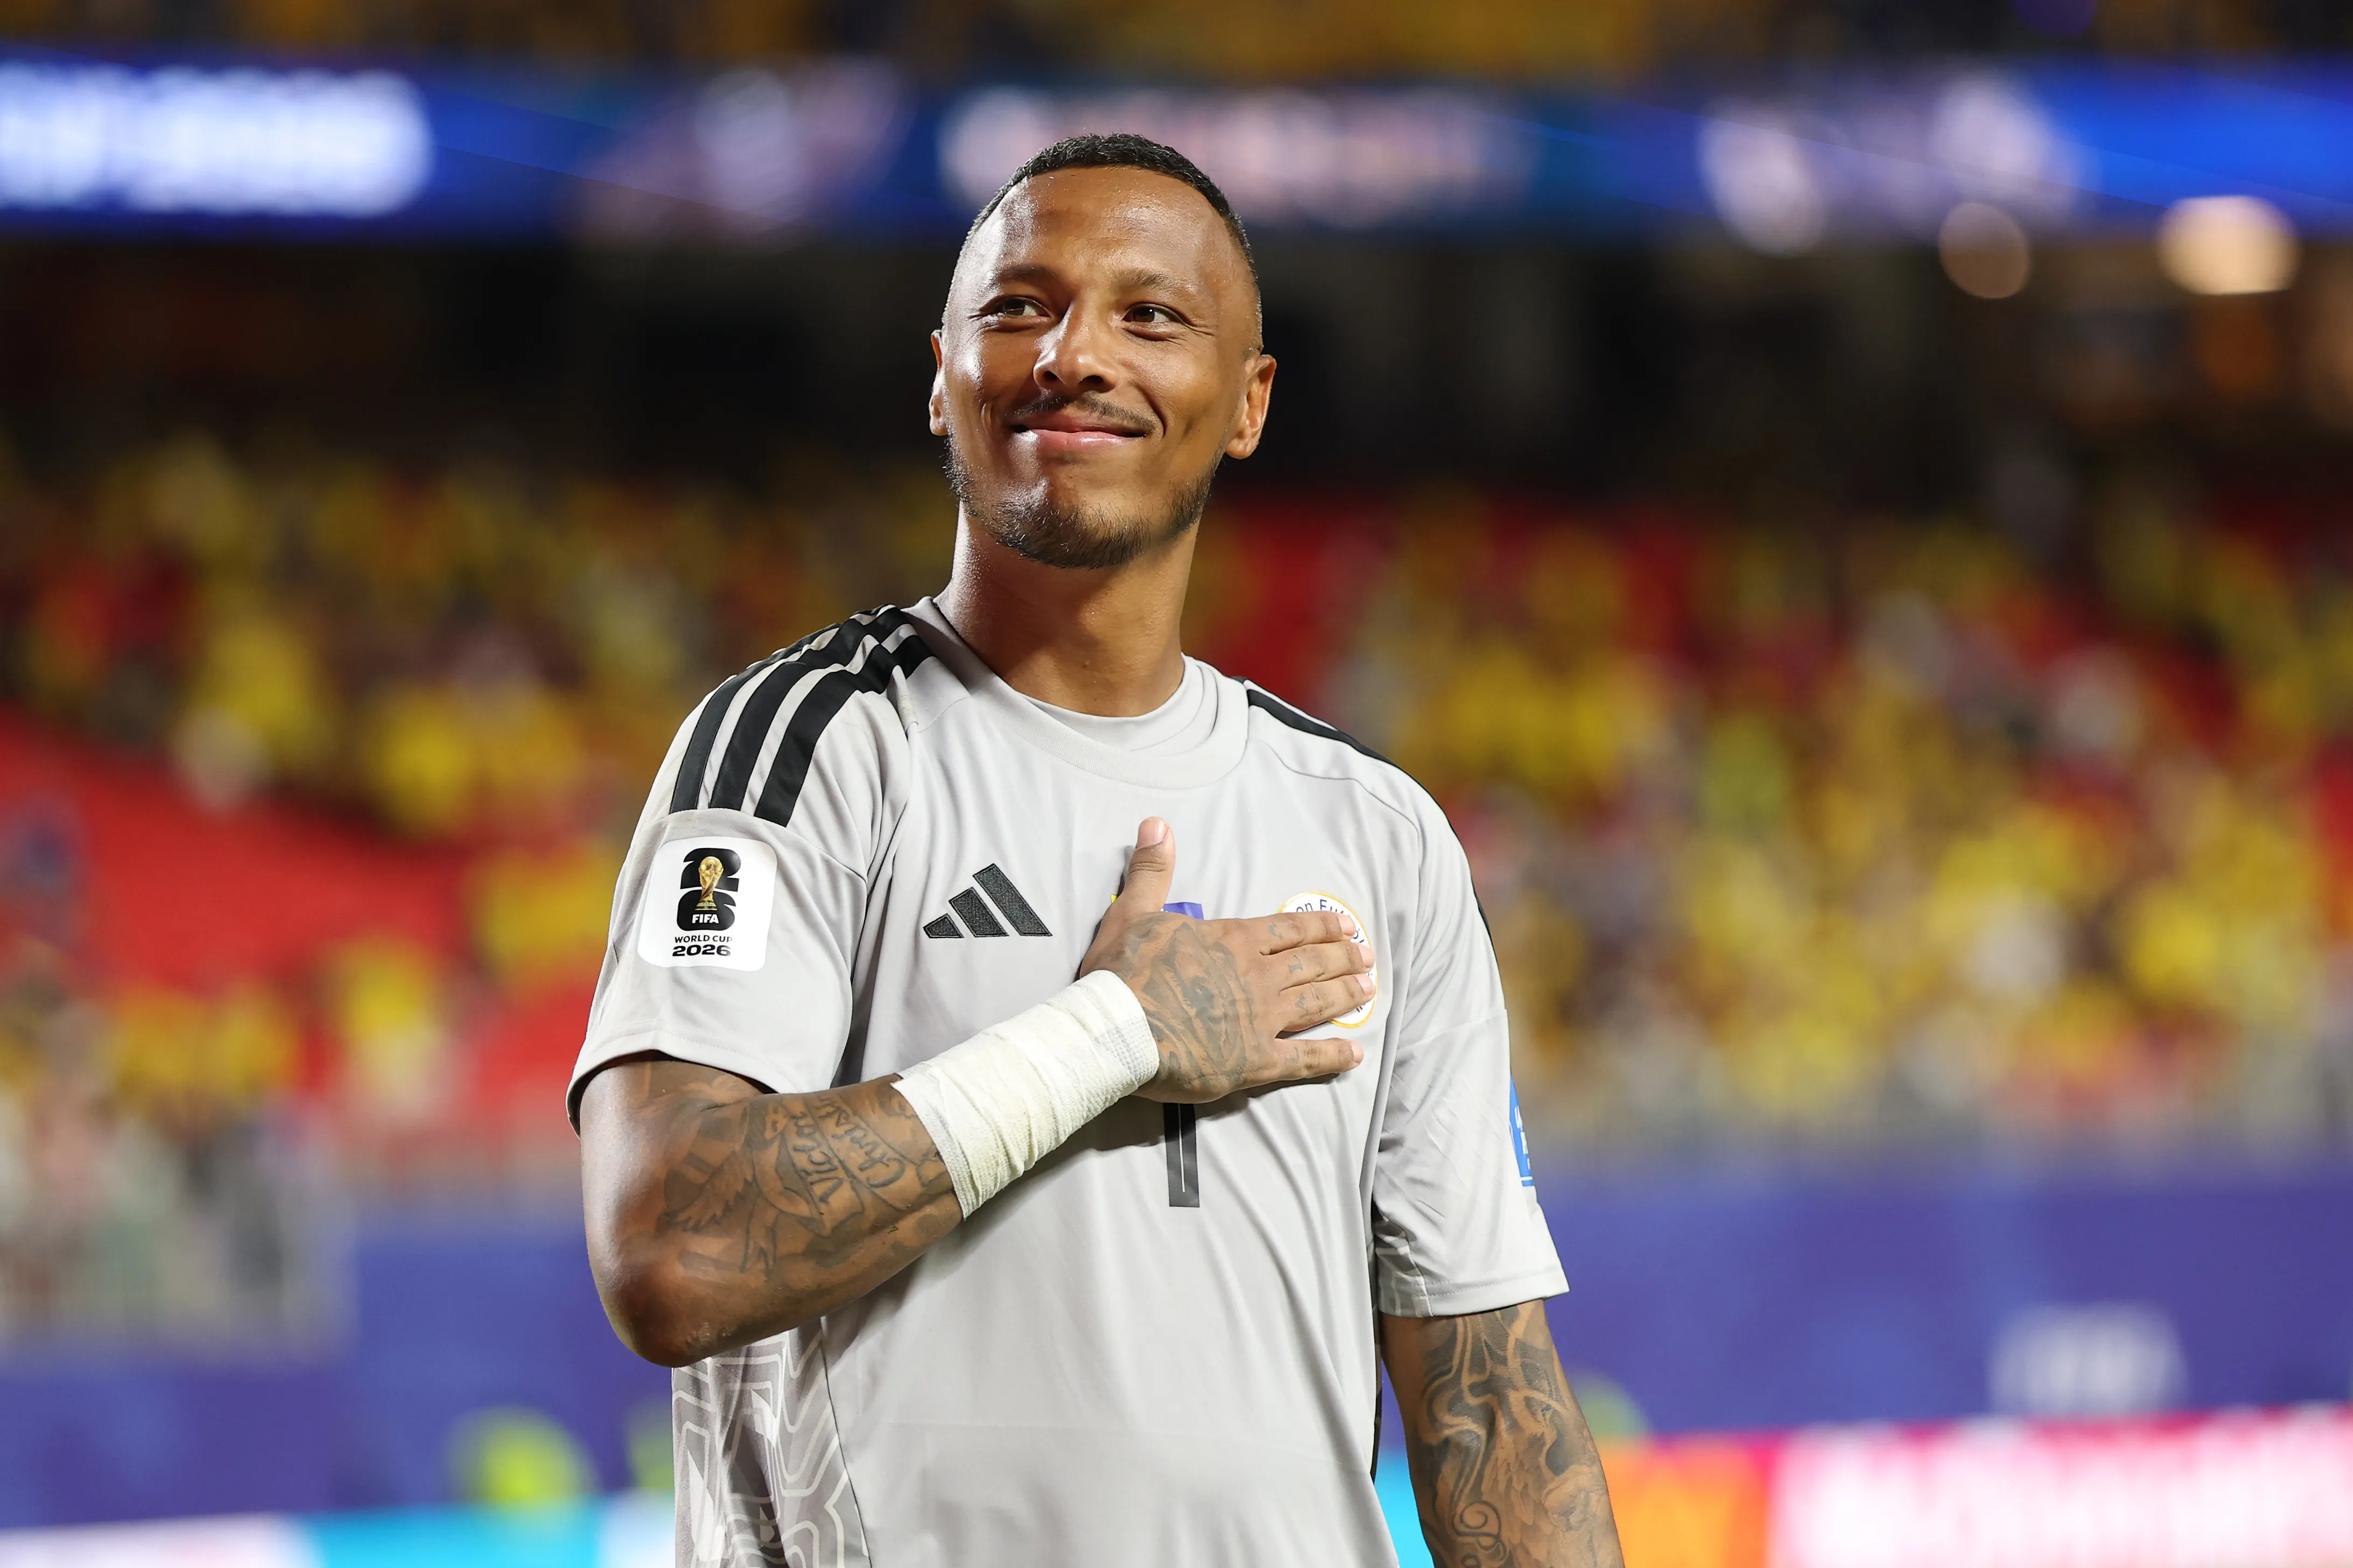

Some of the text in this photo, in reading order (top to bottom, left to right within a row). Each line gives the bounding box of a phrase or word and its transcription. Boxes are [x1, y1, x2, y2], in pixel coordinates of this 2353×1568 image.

[692, 914, 719, 924] FIFA
[675, 935, 710, 943] WORLD
[672, 944, 731, 957] 2026
